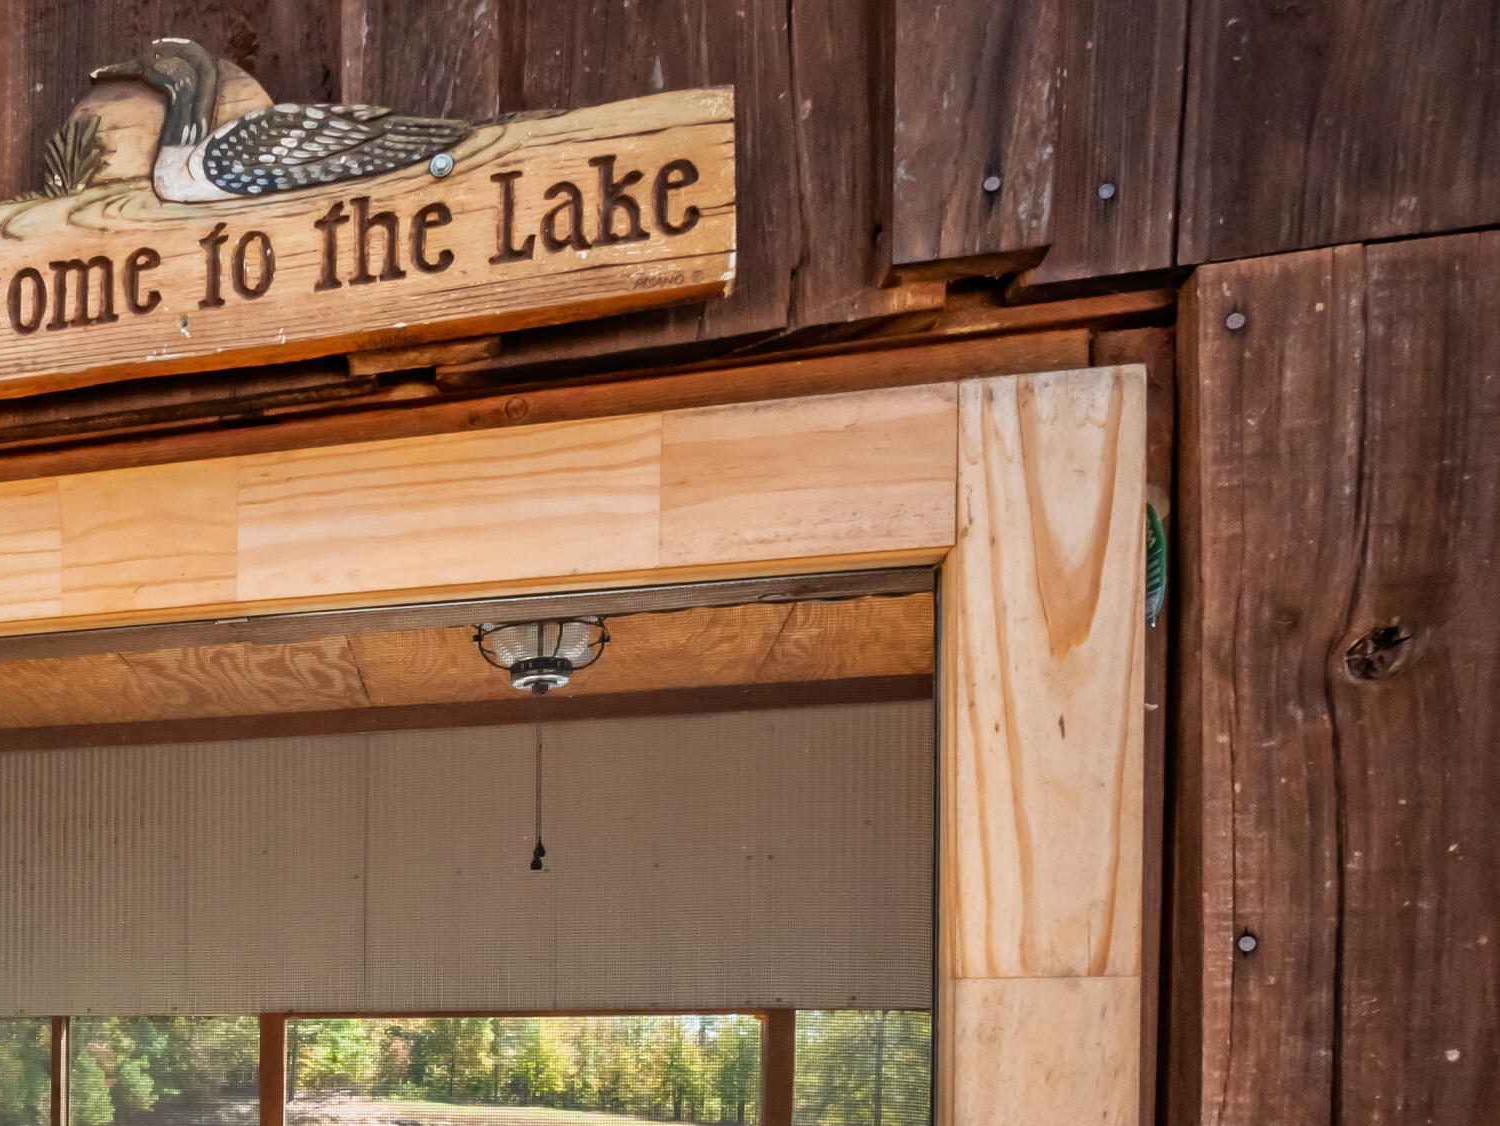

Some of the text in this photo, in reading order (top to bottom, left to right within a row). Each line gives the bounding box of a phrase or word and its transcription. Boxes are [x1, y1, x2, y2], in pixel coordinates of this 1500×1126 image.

[198, 222, 277, 311] to
[313, 195, 454, 292] the
[488, 154, 702, 267] Lake
